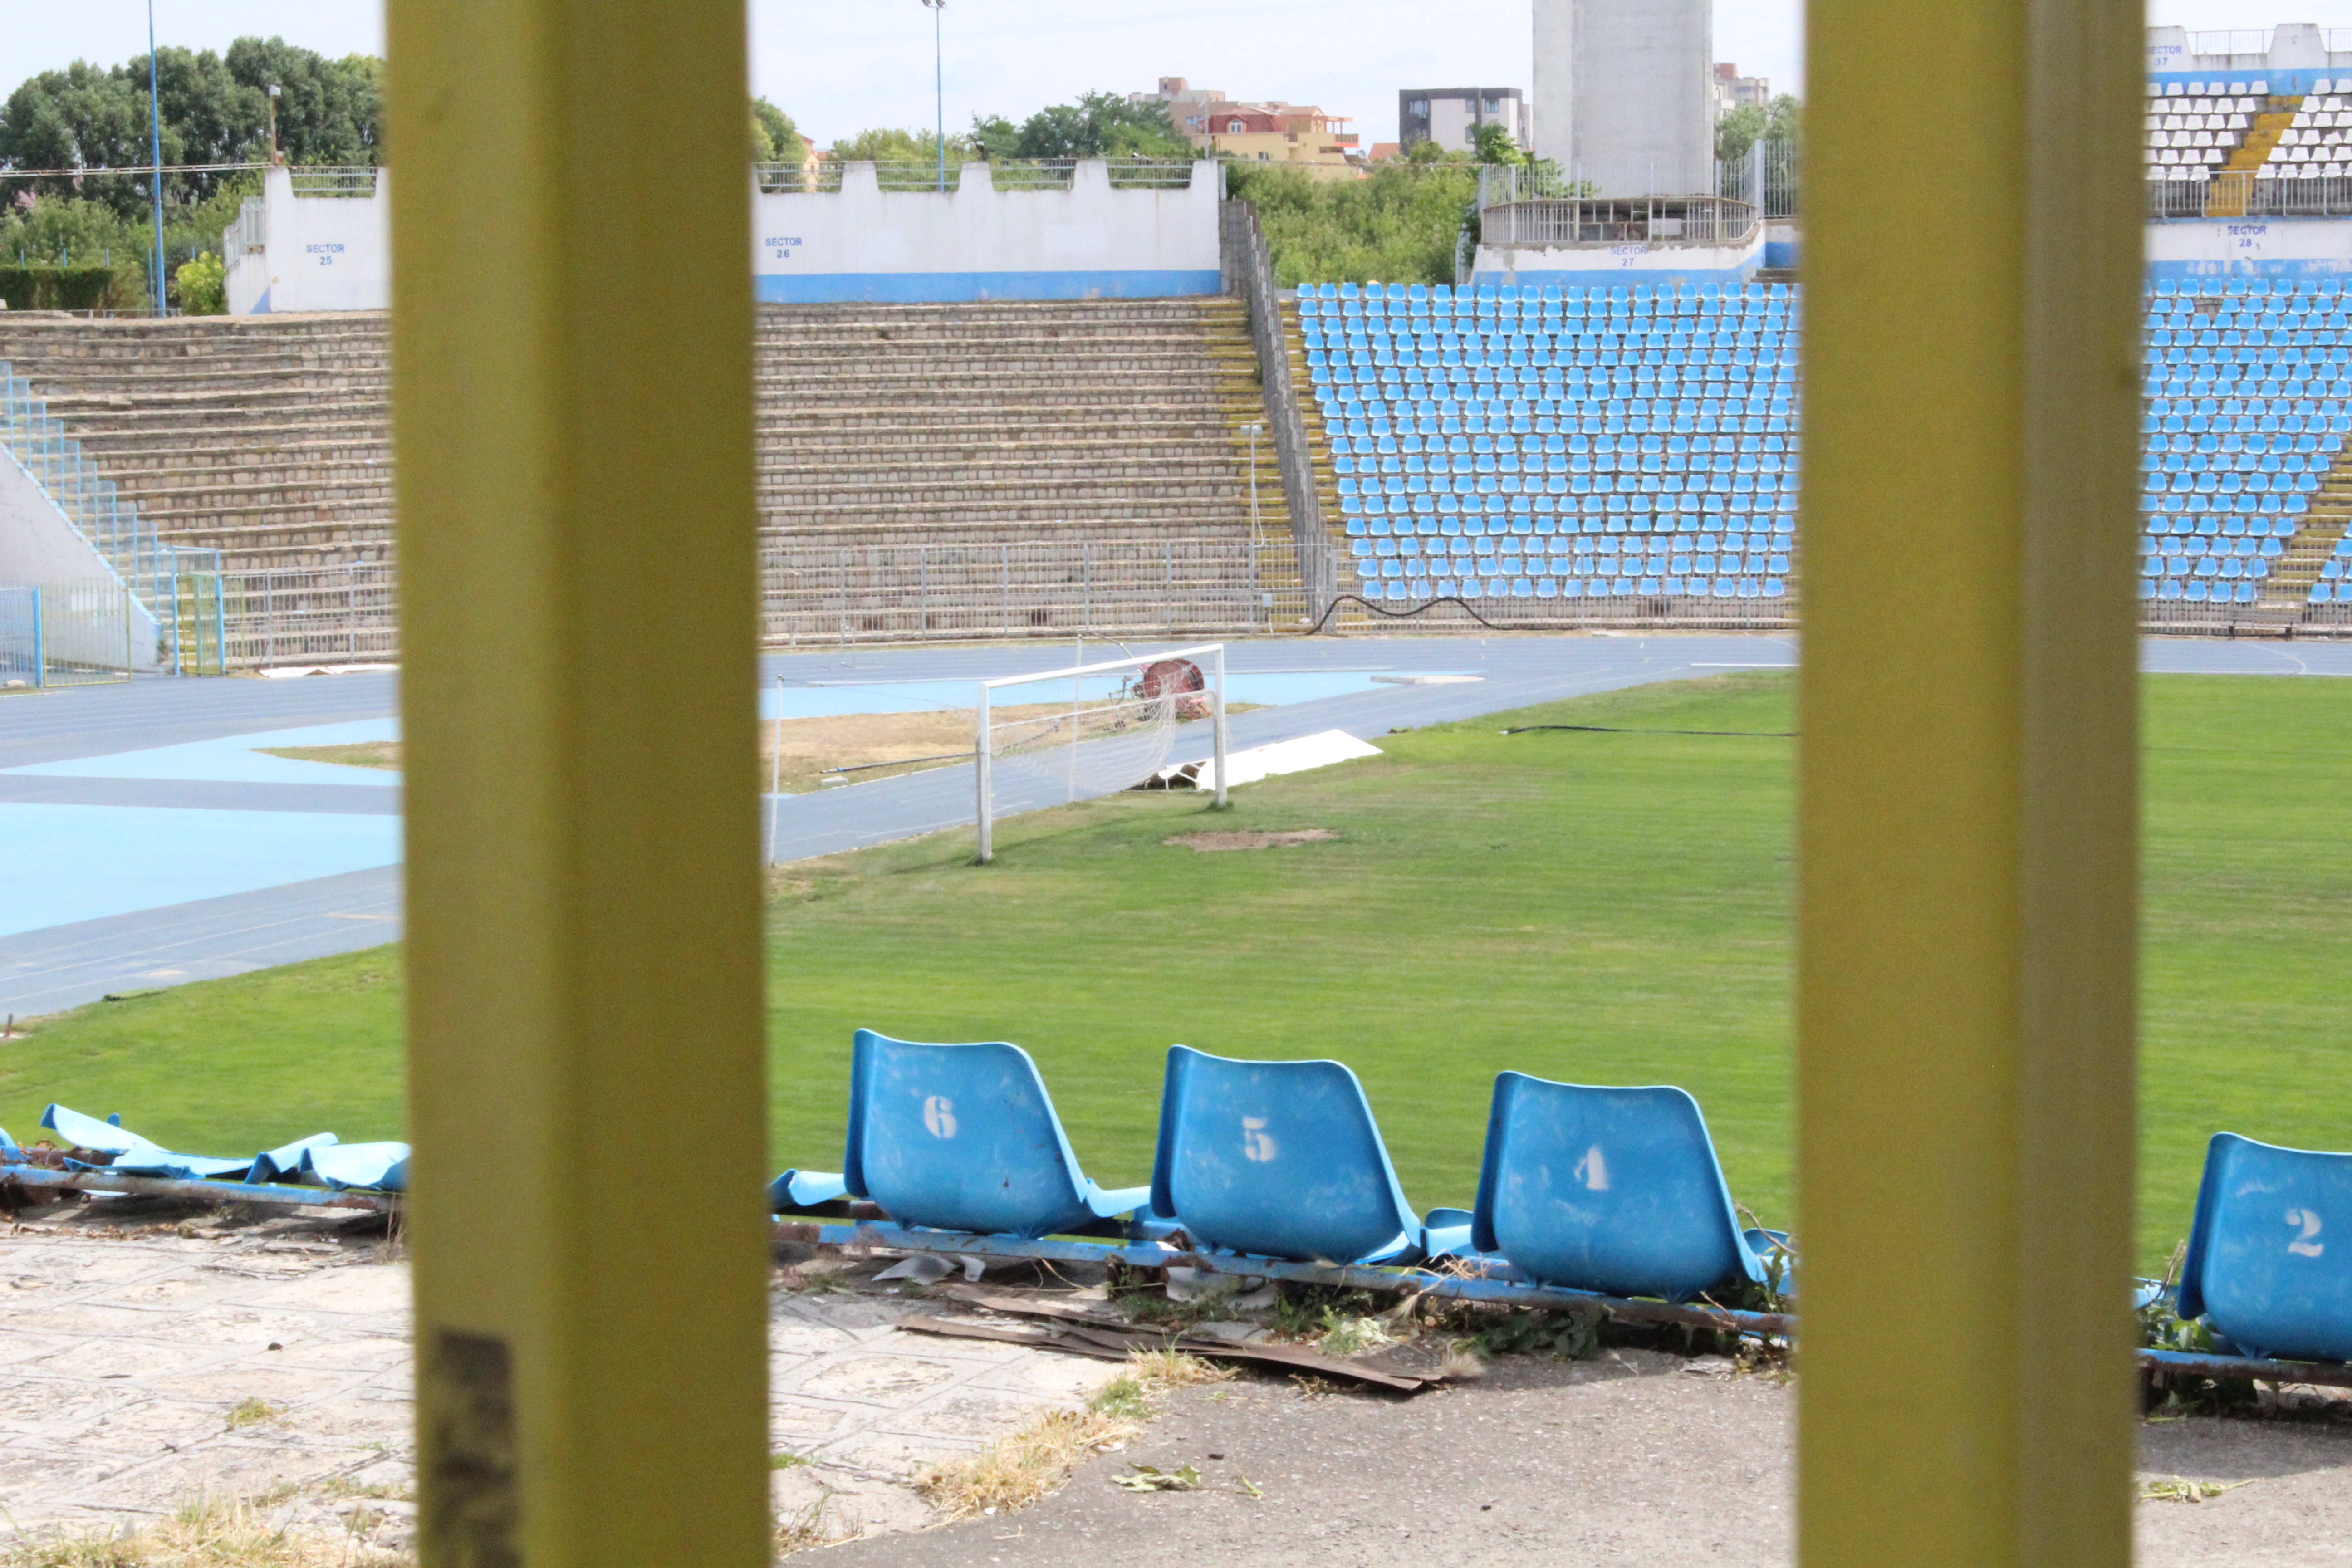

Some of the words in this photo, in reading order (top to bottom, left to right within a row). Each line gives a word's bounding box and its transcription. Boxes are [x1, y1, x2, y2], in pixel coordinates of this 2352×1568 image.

[2228, 225, 2266, 235] SECTOR
[765, 237, 802, 246] SECTOR
[2239, 238, 2252, 247] 28
[306, 244, 344, 253] SECTOR
[1610, 246, 1647, 255] SECTOR
[777, 249, 790, 258] 26
[319, 256, 332, 265] 25
[1622, 258, 1634, 266] 27
[922, 1095, 958, 1139] 6
[1241, 1117, 1278, 1162] 5
[1574, 1145, 1609, 1190] 1
[2285, 1207, 2324, 1257] 2
